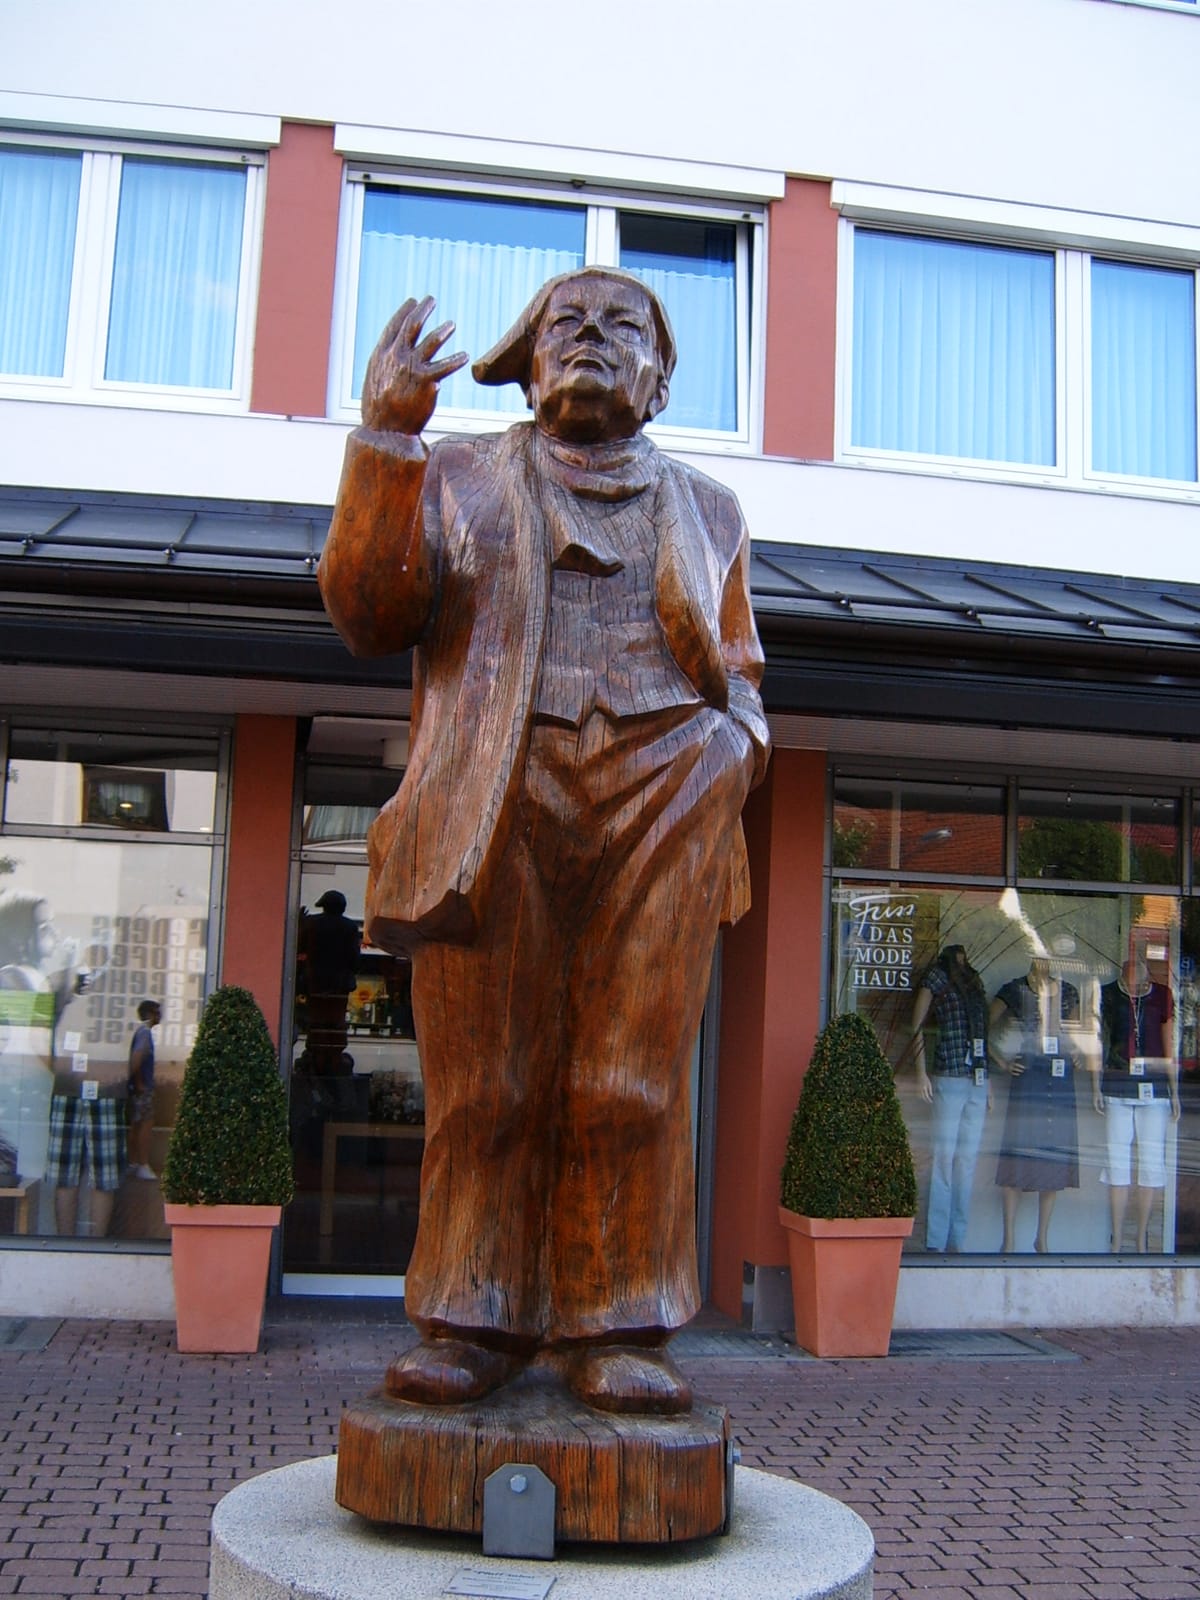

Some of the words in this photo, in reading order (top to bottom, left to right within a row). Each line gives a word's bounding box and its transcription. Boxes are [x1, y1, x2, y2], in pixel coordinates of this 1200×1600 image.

[870, 926, 913, 943] DAS
[855, 947, 912, 965] MODE
[853, 969, 909, 987] HAUS
